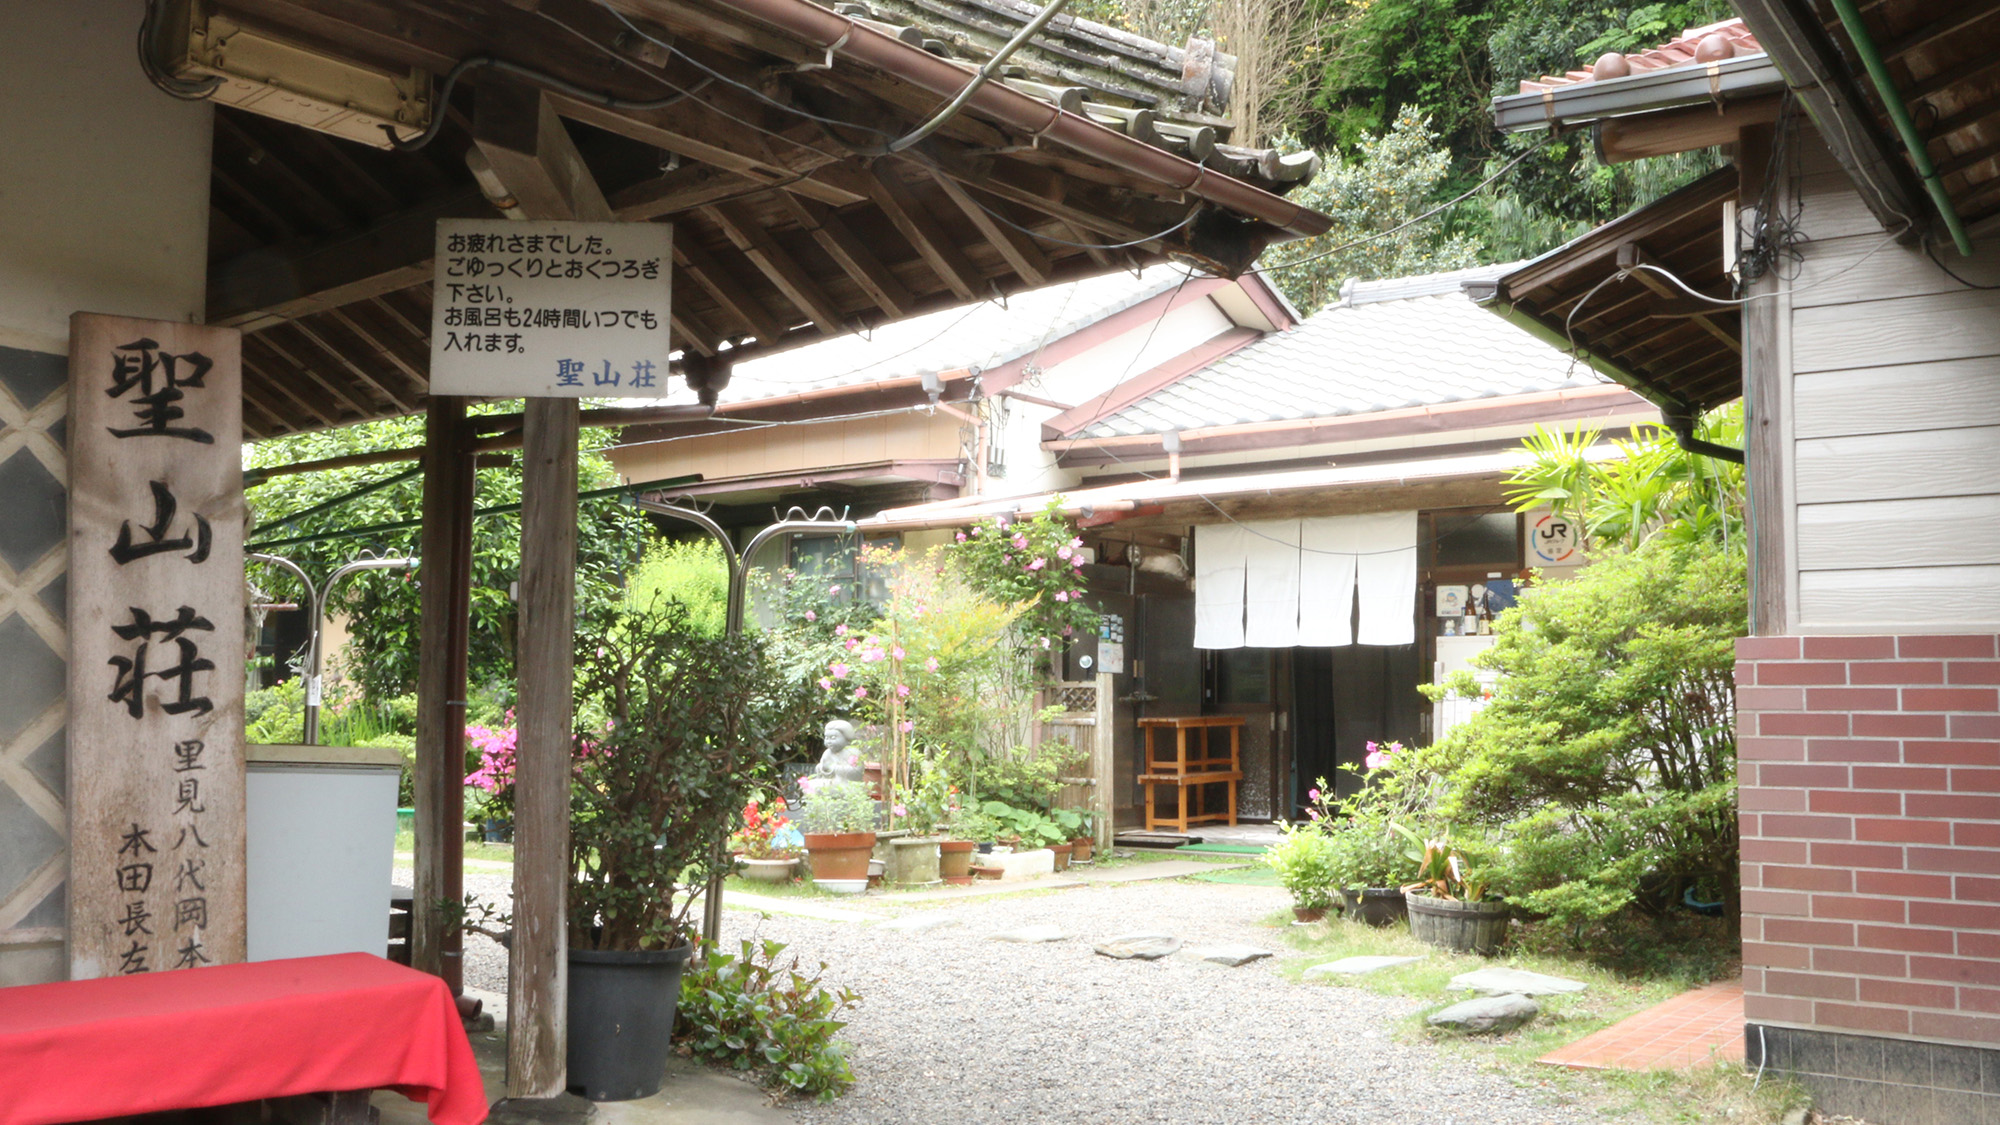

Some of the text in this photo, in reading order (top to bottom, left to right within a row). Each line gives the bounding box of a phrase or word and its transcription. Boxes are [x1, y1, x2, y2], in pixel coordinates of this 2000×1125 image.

[446, 233, 613, 255] お疲れさまでした。
[446, 256, 660, 279] ごゆっくりとおくつろぎ
[446, 283, 514, 304] 下さい。
[444, 307, 658, 330] お風呂も24時間いつでも
[443, 331, 526, 354] 入れます。
[556, 358, 656, 389] 聖山荘
[105, 337, 215, 720] 聖山荘
[1541, 523, 1567, 539] JR
[172, 739, 212, 969] 里見八代岡本
